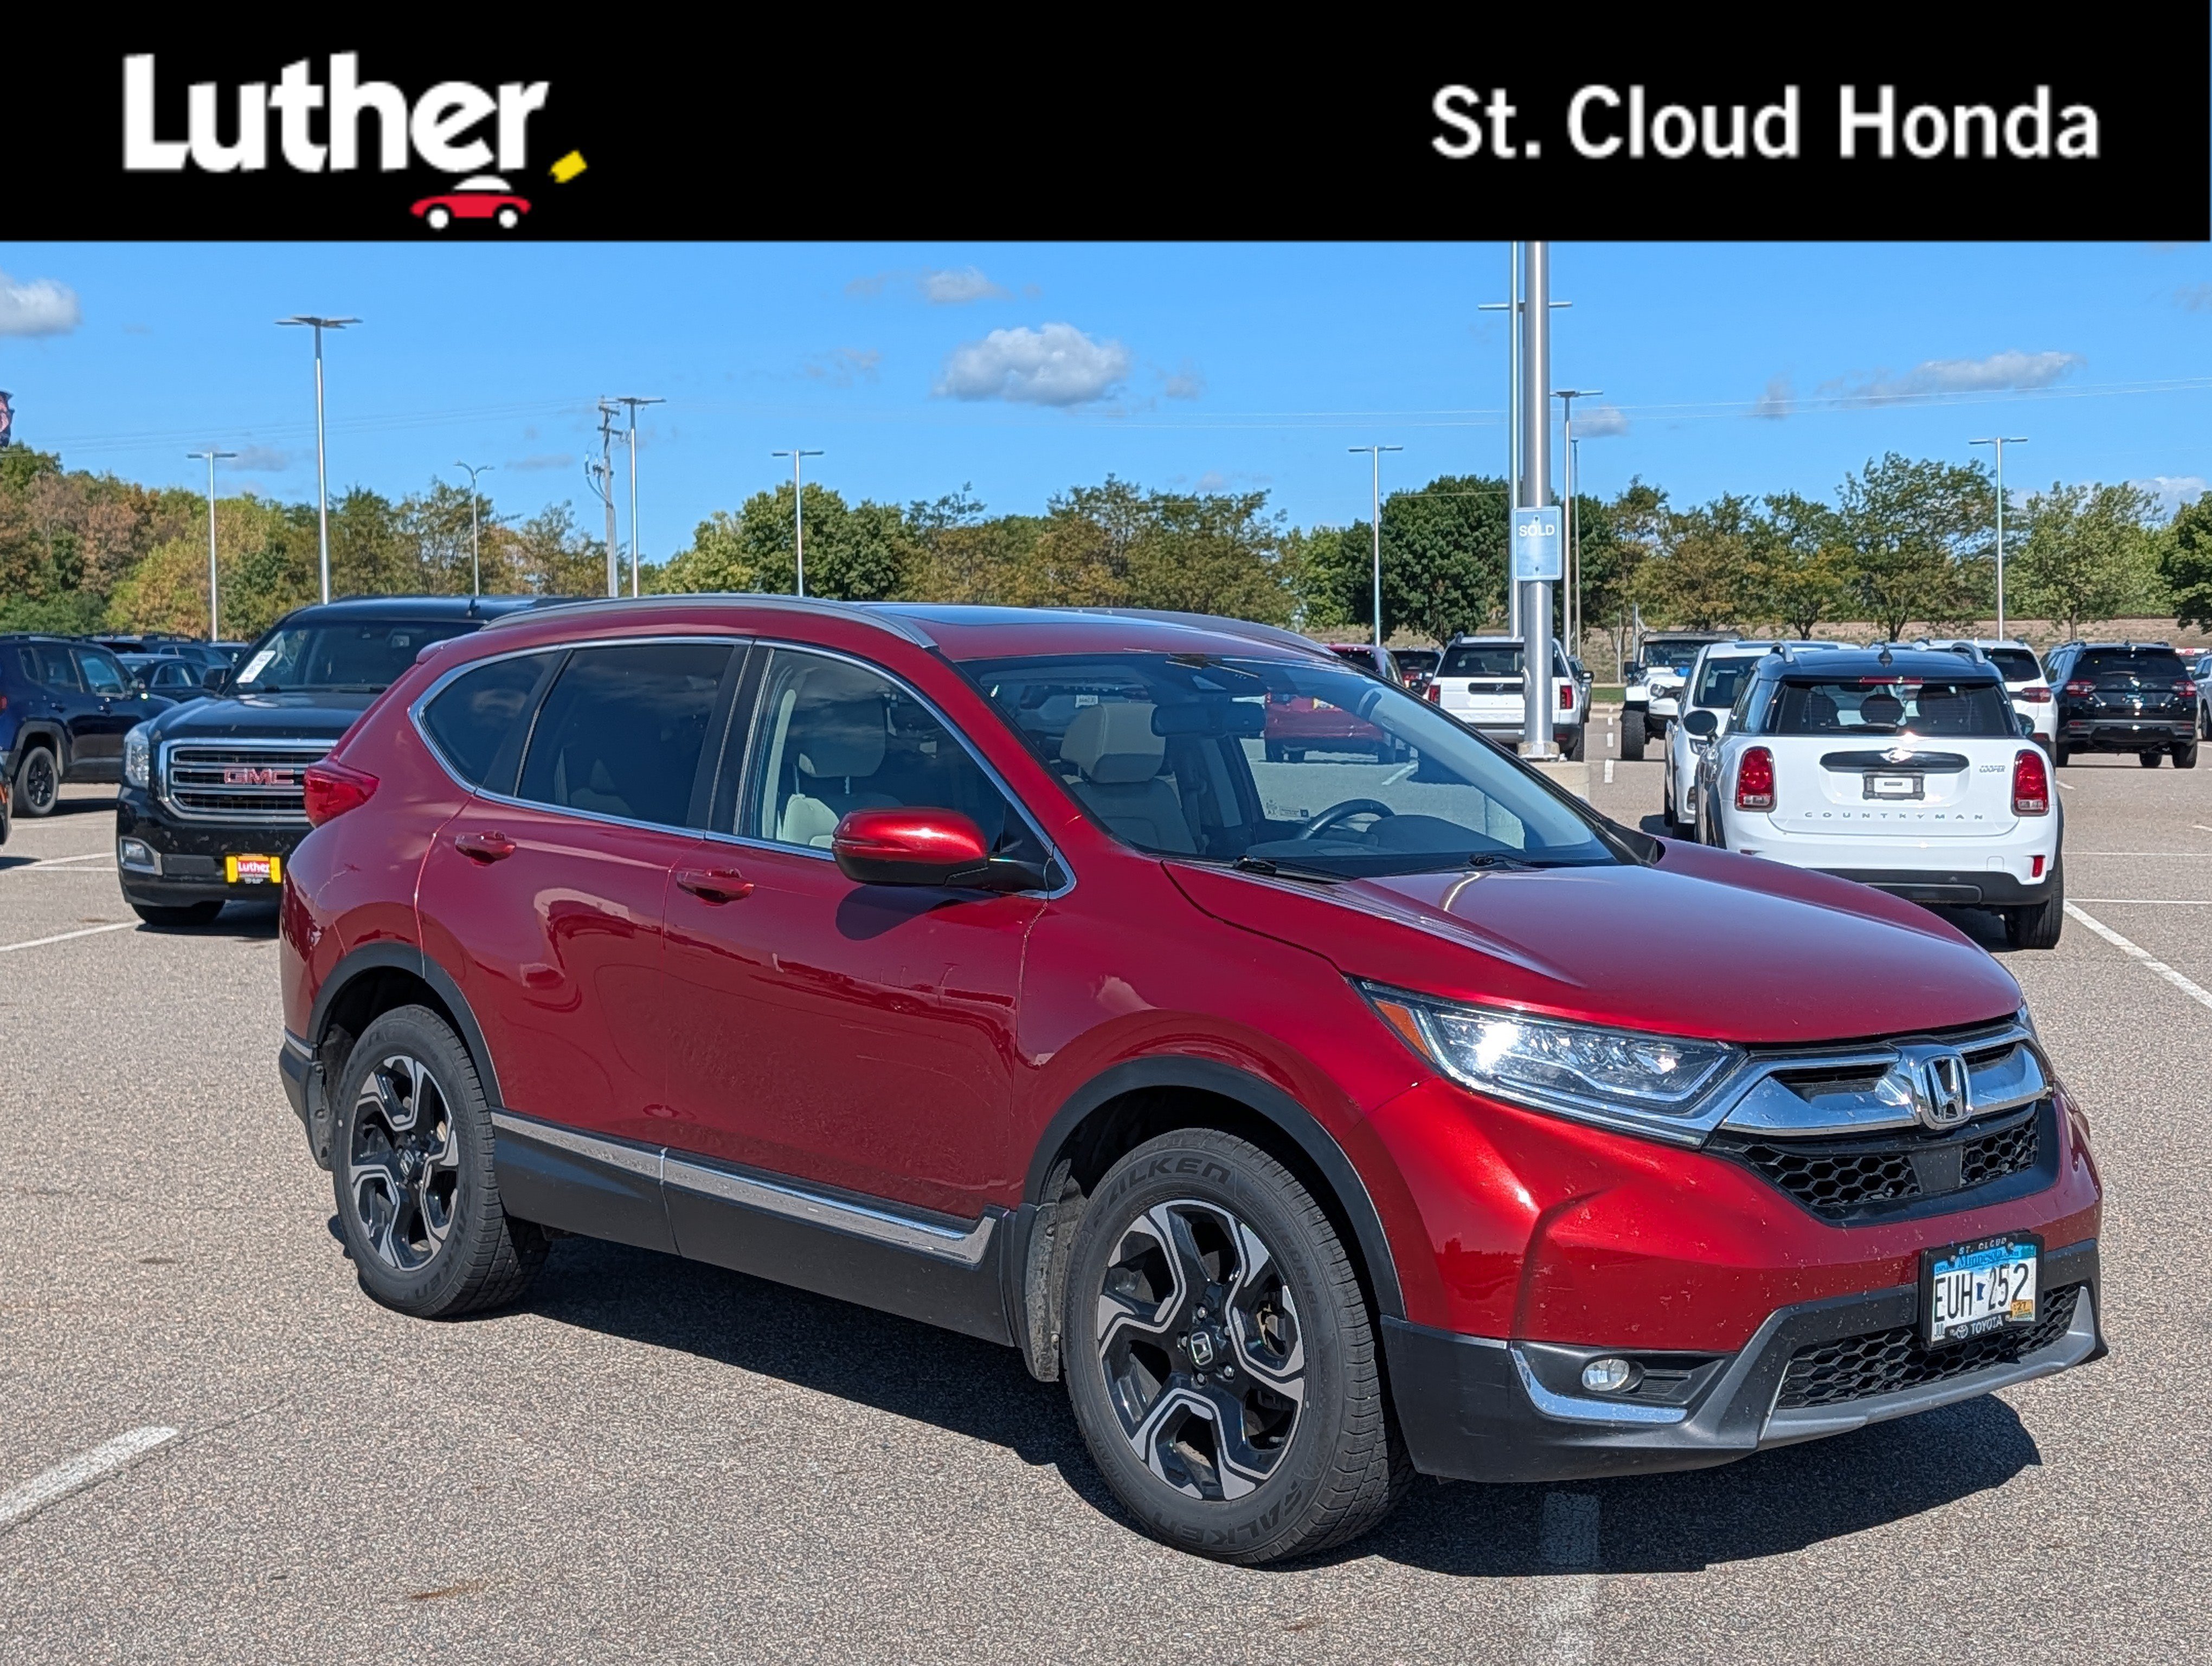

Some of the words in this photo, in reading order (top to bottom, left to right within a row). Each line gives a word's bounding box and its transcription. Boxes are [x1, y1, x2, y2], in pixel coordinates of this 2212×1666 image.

[1519, 524, 1555, 537] SOLD
[224, 767, 294, 785] GMC
[1805, 812, 1983, 820] COUNTRYMAN
[237, 862, 270, 873] Luther
[1958, 1250, 2003, 1267] Minnesota
[1934, 1272, 1974, 1323] EUH
[1988, 1263, 2030, 1311] 252
[2016, 1301, 2027, 1311] 27
[1970, 1315, 2003, 1335] TOYOTA
[1153, 1480, 1303, 1546] FALKEN
